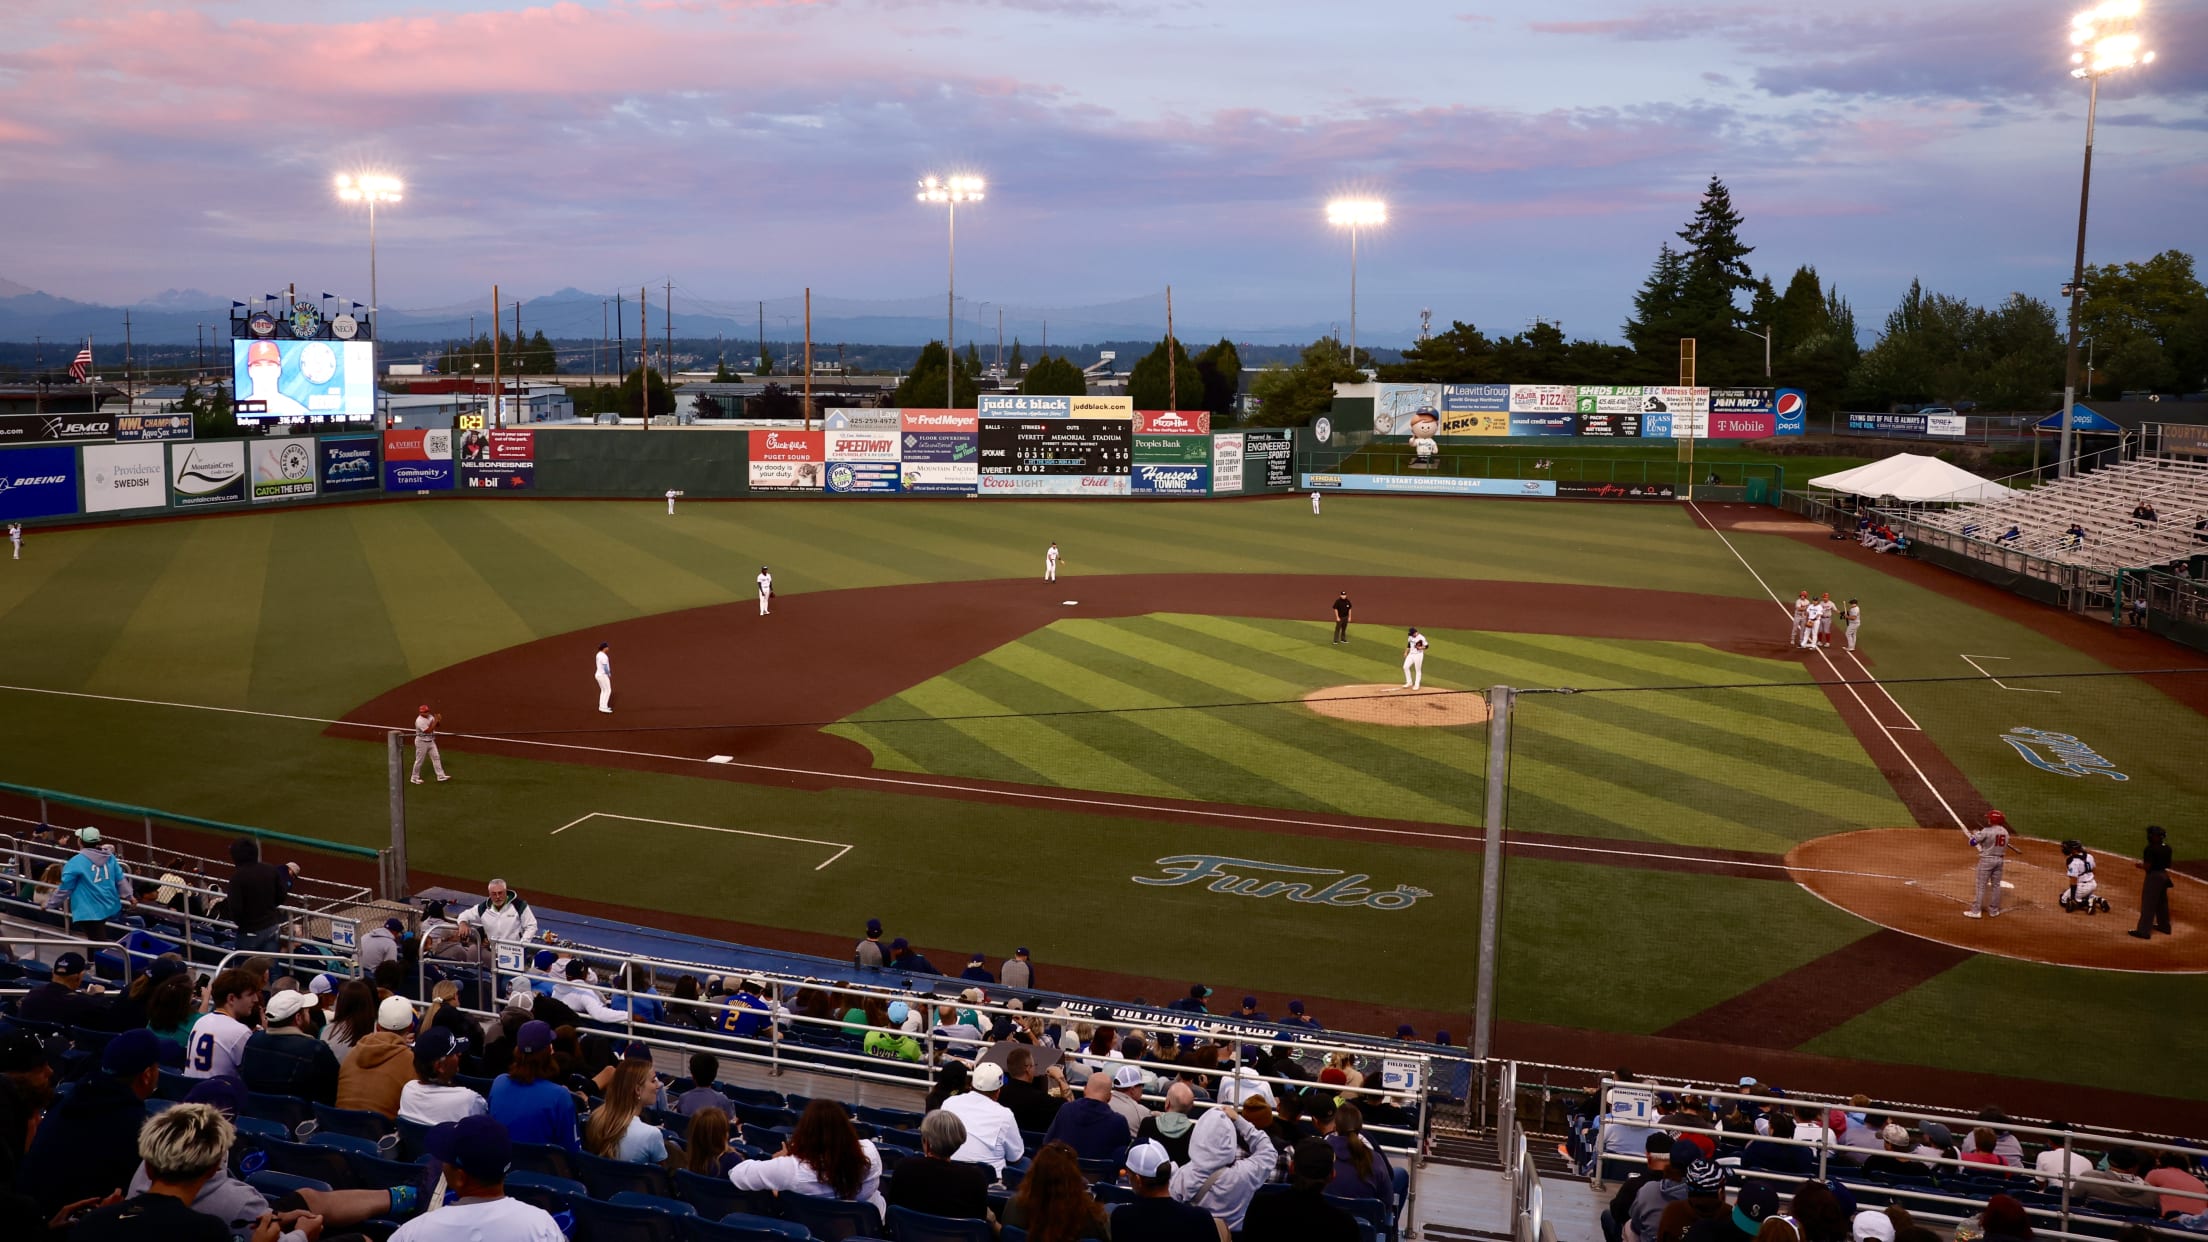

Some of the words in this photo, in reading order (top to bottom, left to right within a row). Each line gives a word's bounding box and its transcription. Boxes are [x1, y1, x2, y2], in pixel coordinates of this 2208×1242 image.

[292, 302, 317, 313] Everett
[292, 324, 318, 337] AquaSox
[1456, 386, 1483, 395] Leavitt
[1484, 386, 1508, 397] Group
[1580, 386, 1612, 395] SHEDS
[1616, 387, 1641, 395] PLUS
[982, 398, 1014, 412] judd
[1016, 398, 1027, 409] &
[1030, 399, 1066, 410] black
[1540, 394, 1567, 405] PIZZA
[1714, 399, 1736, 407] JOIN
[1737, 398, 1759, 407] MPD
[118, 417, 144, 430] NWL
[144, 416, 190, 428] CHAMPIONS
[460, 416, 482, 429] 0:23
[1153, 419, 1173, 427] Pizza
[1174, 419, 1188, 427] Hut
[2072, 415, 2092, 424] pepsi
[61, 422, 109, 432] JEMCO
[1730, 421, 1764, 432] Mobile
[142, 428, 169, 439] AquaSox
[835, 440, 893, 452] SPEEDWAY
[1135, 440, 1162, 449] Peoples
[1162, 440, 1181, 448] Bank
[1247, 442, 1290, 452] ENGINEERED
[1268, 451, 1290, 459] SPORTS
[114, 464, 160, 476] Providence
[191, 462, 234, 470] MountainCrest
[397, 468, 439, 477] community
[1141, 466, 1198, 480] Hansen's
[14, 475, 66, 486] BOEING
[114, 478, 149, 488] SWEDISH
[469, 477, 498, 487] Mobil
[983, 476, 1015, 487] Coors
[1082, 477, 1109, 487] Chill
[1153, 480, 1187, 489] TOWING
[255, 486, 280, 496] CATCH
[280, 485, 292, 494] THE
[293, 483, 313, 493] FEVER
[182, 494, 238, 504] mountaincrestcu.com
[1995, 835, 2005, 846] 16
[91, 863, 109, 883] 21
[1130, 854, 1434, 910] Funko
[344, 932, 353, 945] K
[514, 956, 519, 968] J
[724, 1010, 740, 1031] 2
[1113, 1008, 1142, 1018] YOUR
[1145, 1013, 1208, 1028] POTENTIAL
[1210, 1022, 1241, 1032] WITH
[186, 1031, 213, 1071] 19
[1405, 1073, 1413, 1087] J
[1637, 1102, 1644, 1116] 1
